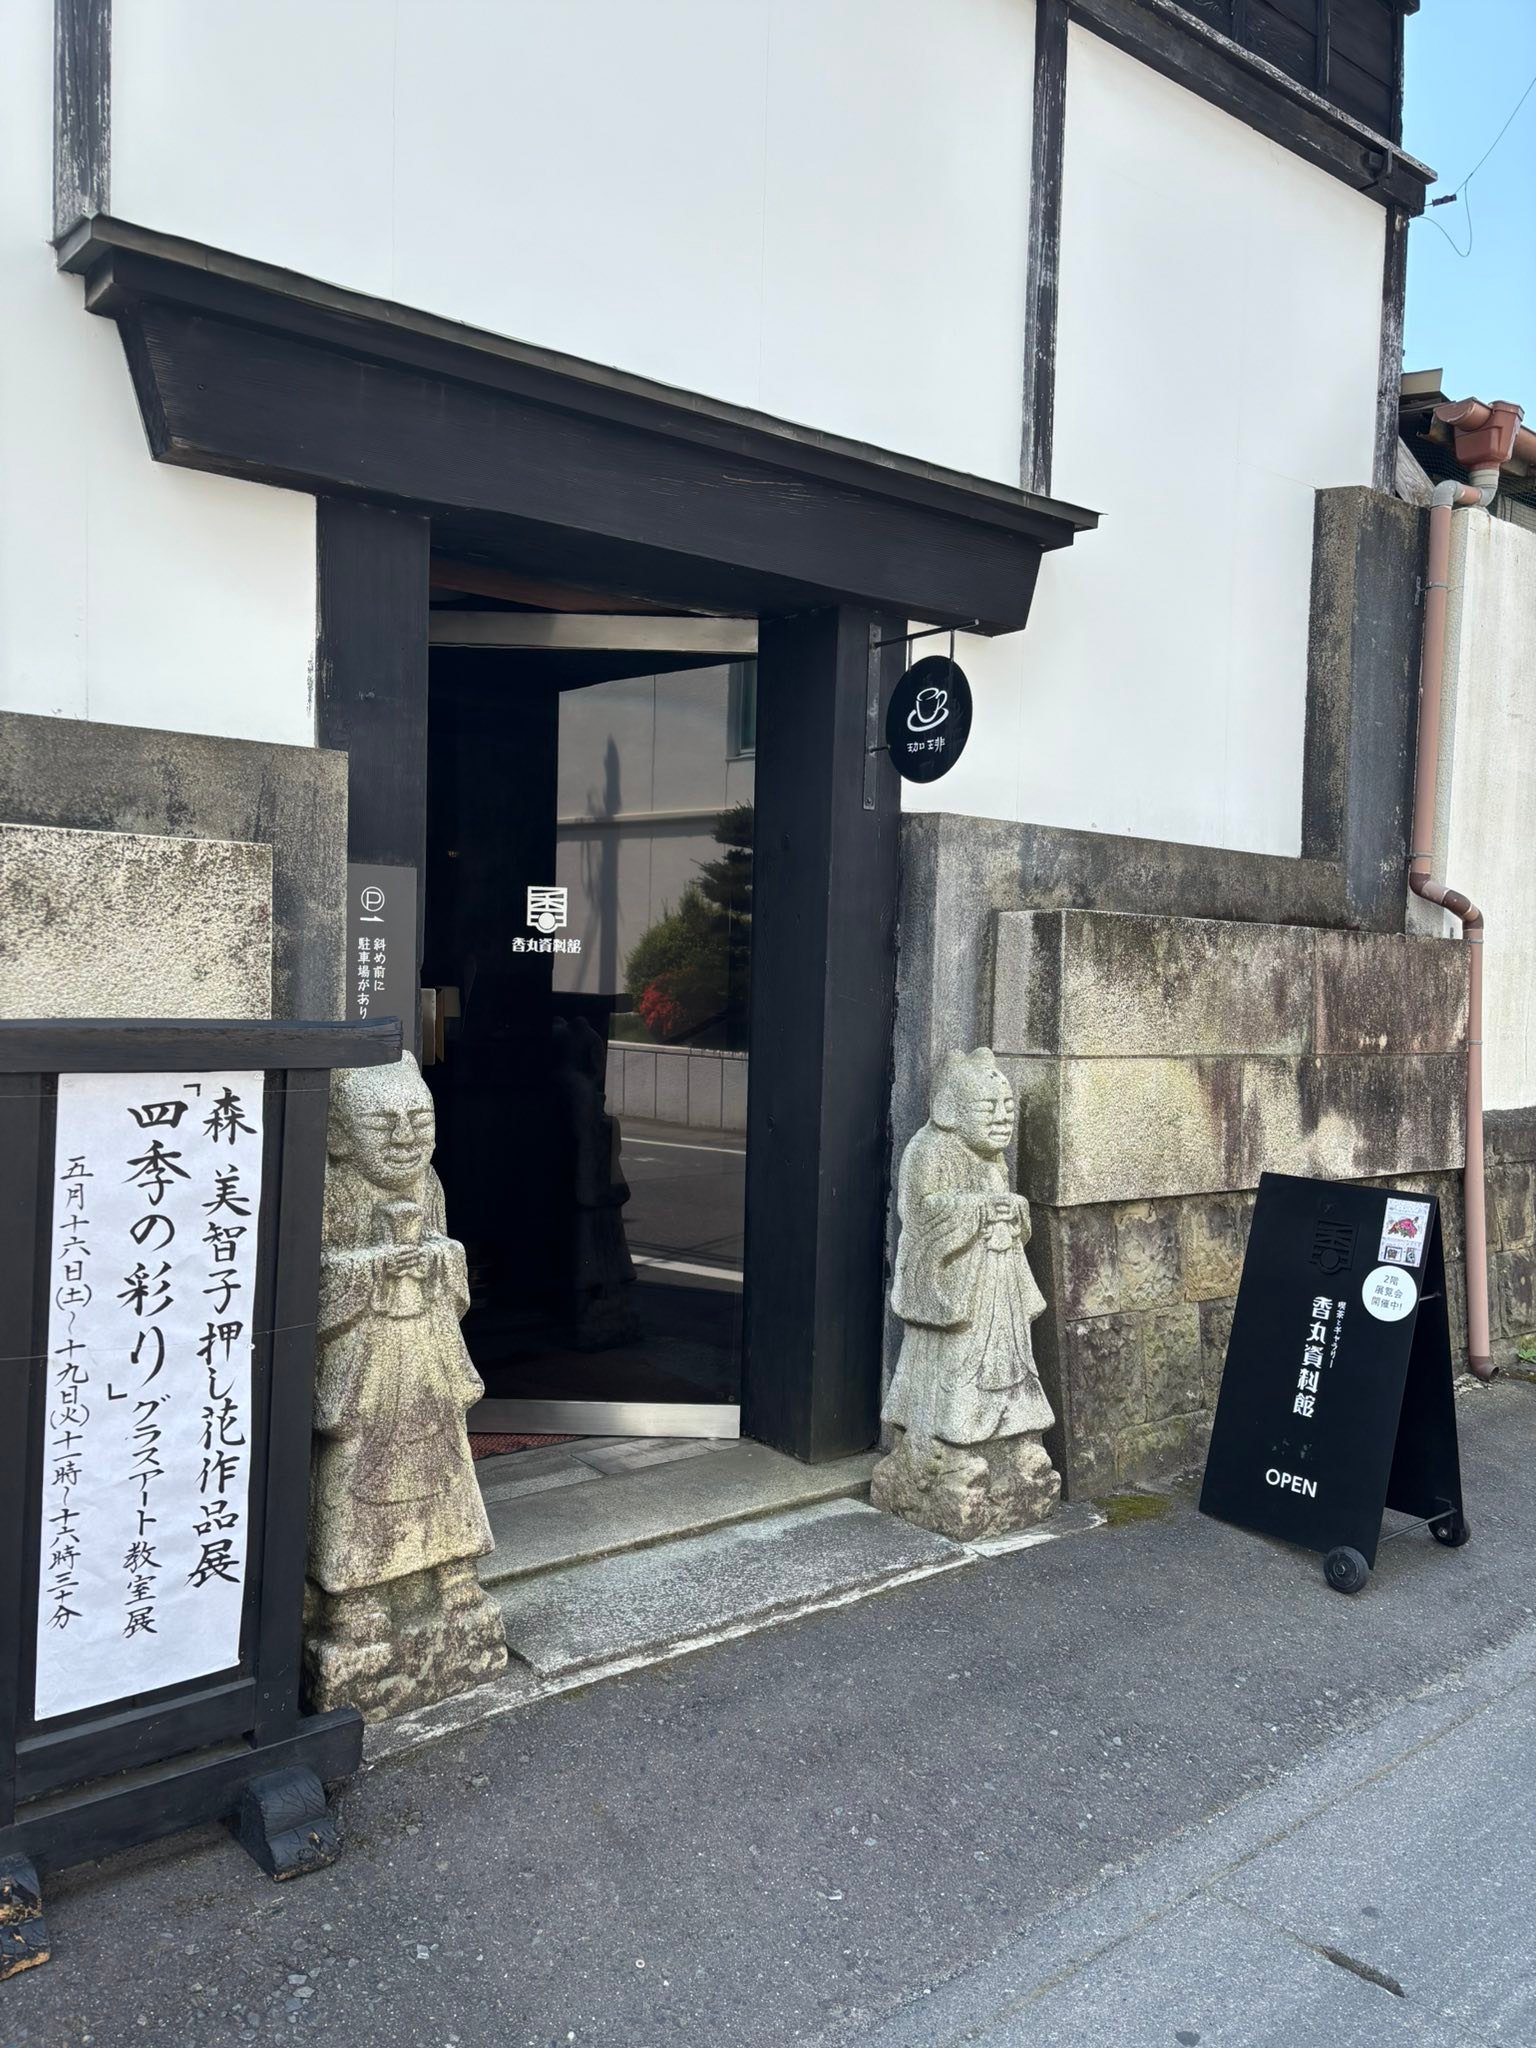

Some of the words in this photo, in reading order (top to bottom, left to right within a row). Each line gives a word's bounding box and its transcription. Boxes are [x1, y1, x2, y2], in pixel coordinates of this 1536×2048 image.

[907, 736, 946, 753] 珈琲
[511, 937, 581, 954] 香丸資料館
[357, 937, 371, 1020] 駐車場があり
[373, 937, 387, 992] 斜め前に
[1374, 1285, 1404, 1299] 展覧会
[1383, 1274, 1399, 1287] 2階
[1329, 1301, 1347, 1368] 喫茶とギャラリー
[1293, 1296, 1333, 1418] 香丸資料館
[1266, 1468, 1318, 1498] OPEN
